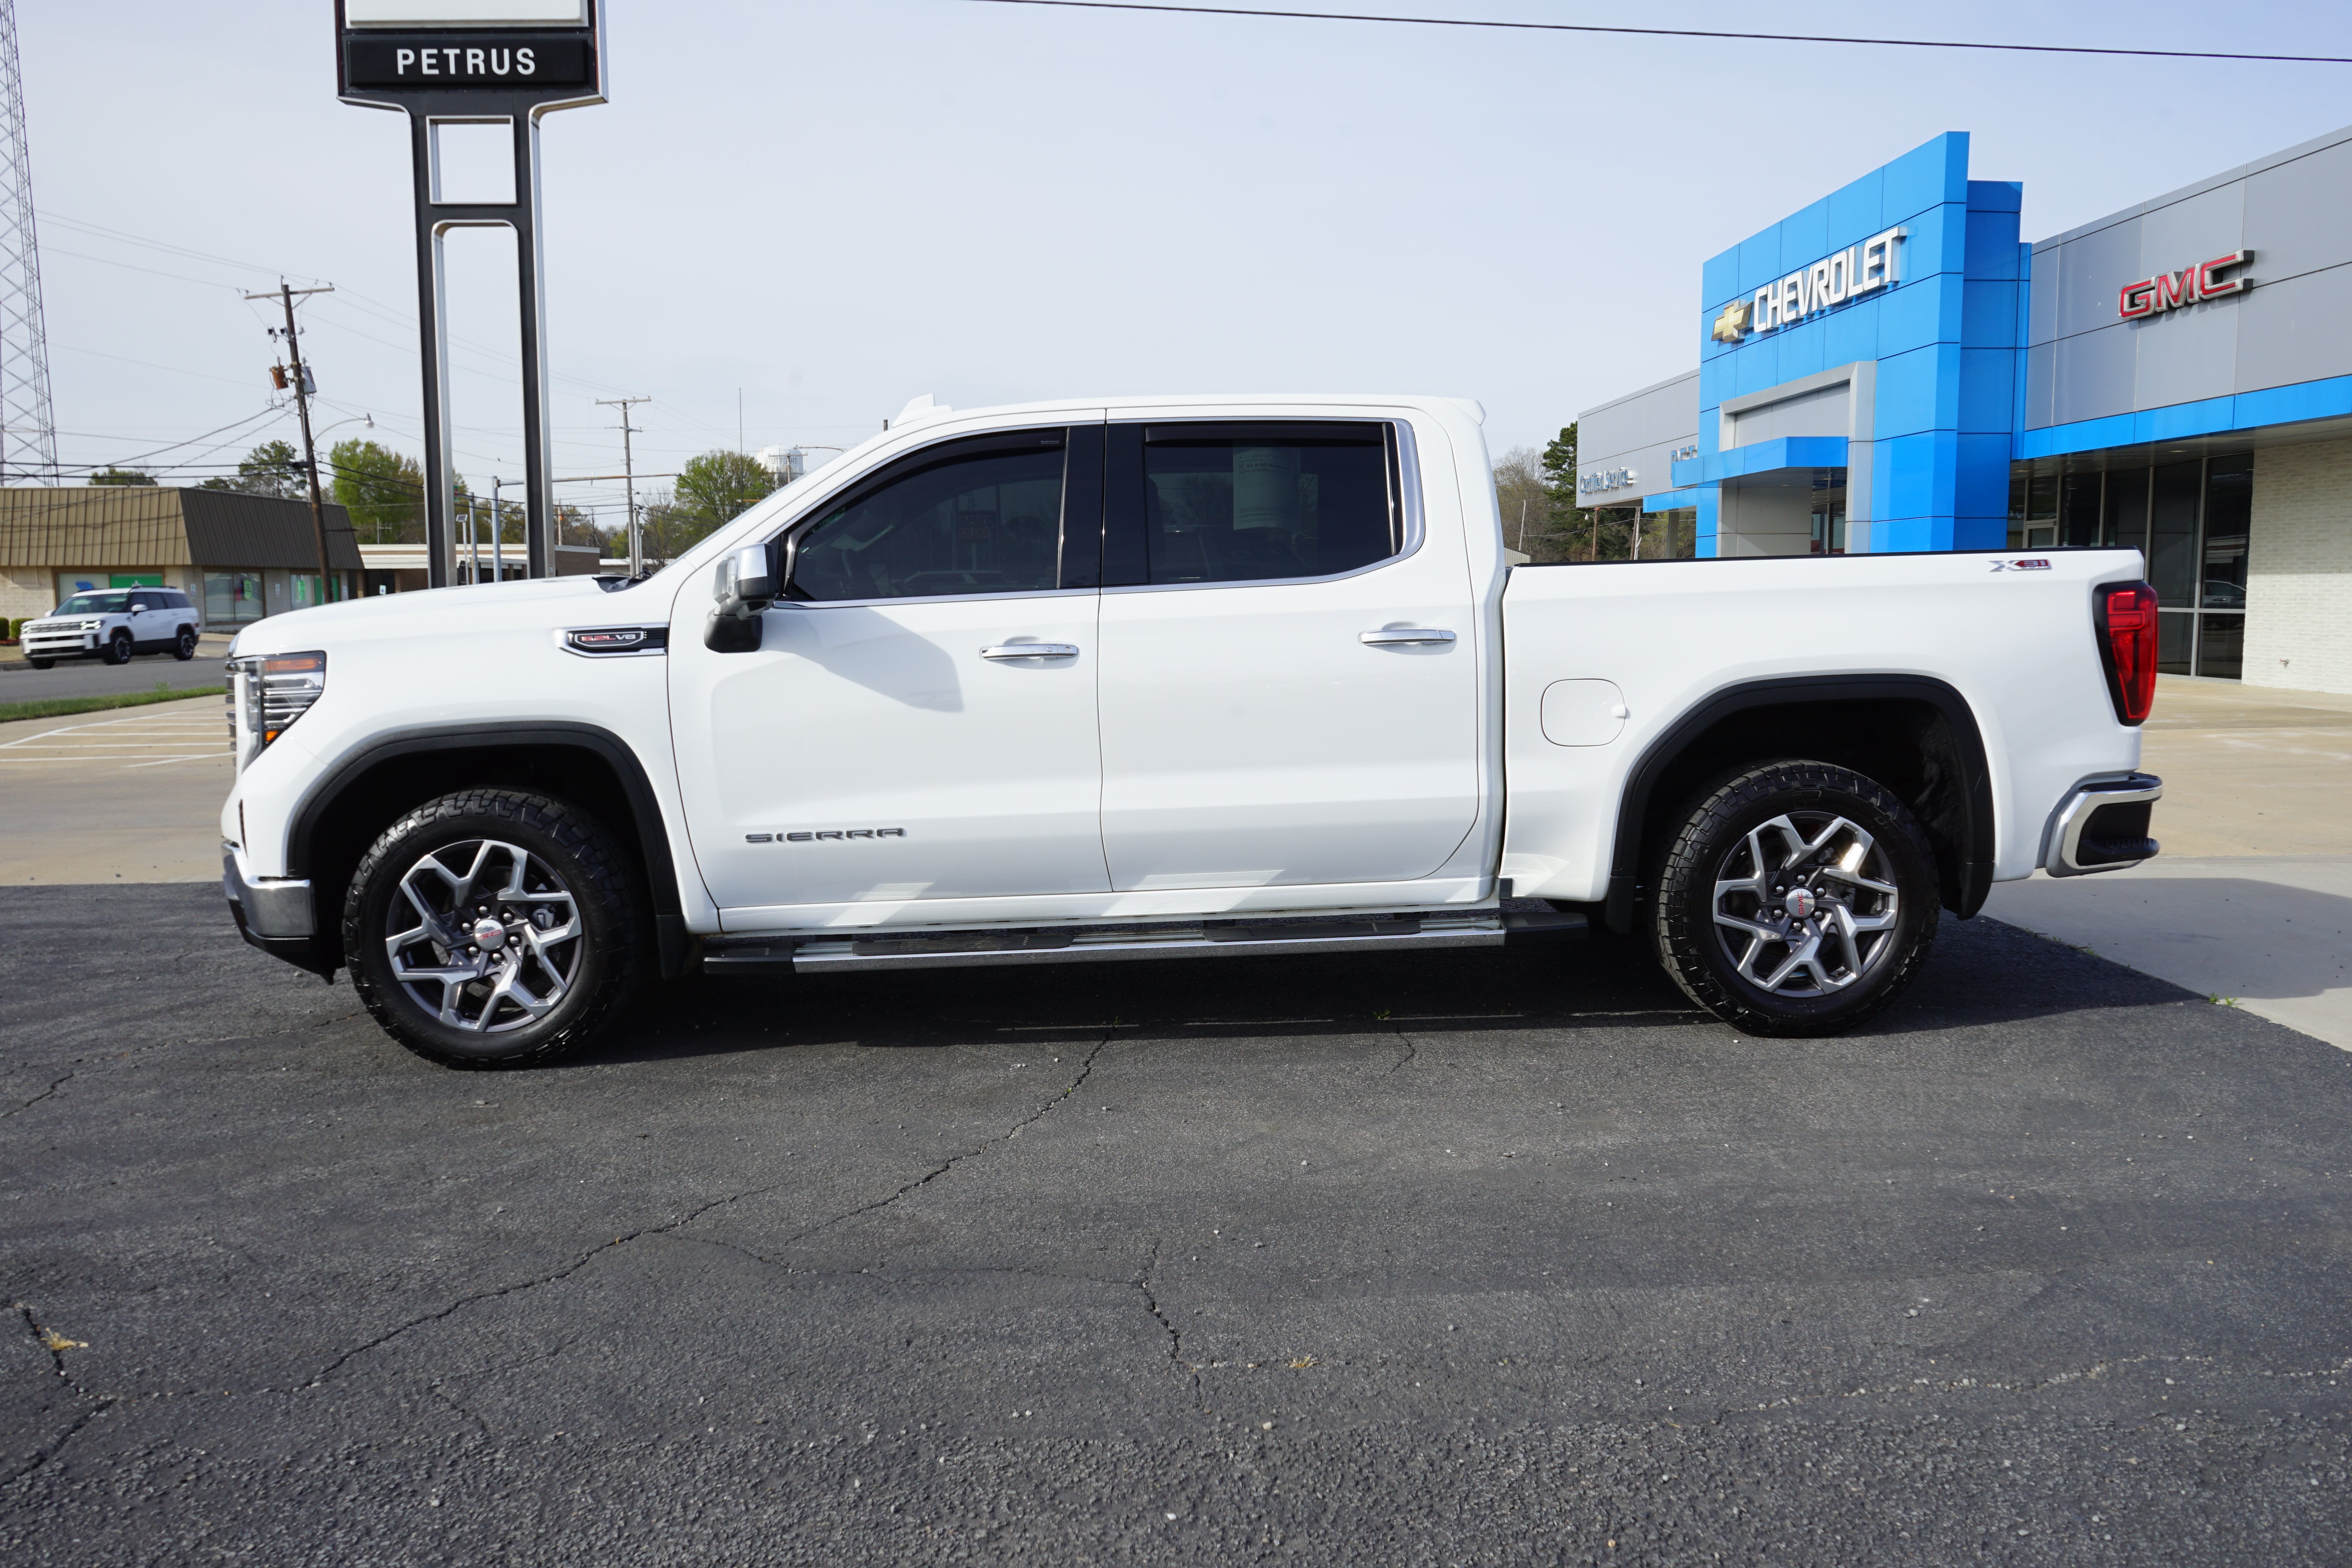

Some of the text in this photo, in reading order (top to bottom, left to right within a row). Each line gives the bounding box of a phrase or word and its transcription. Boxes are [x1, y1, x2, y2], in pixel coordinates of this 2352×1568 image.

[397, 47, 536, 75] PETRUS
[1753, 227, 1905, 333] CHEVROLET
[2118, 249, 2250, 321] GMC
[1580, 468, 1631, 493] Certified Service
[1988, 559, 2049, 572] X31
[745, 827, 904, 842] SIERRA
[476, 929, 502, 941] GMC
